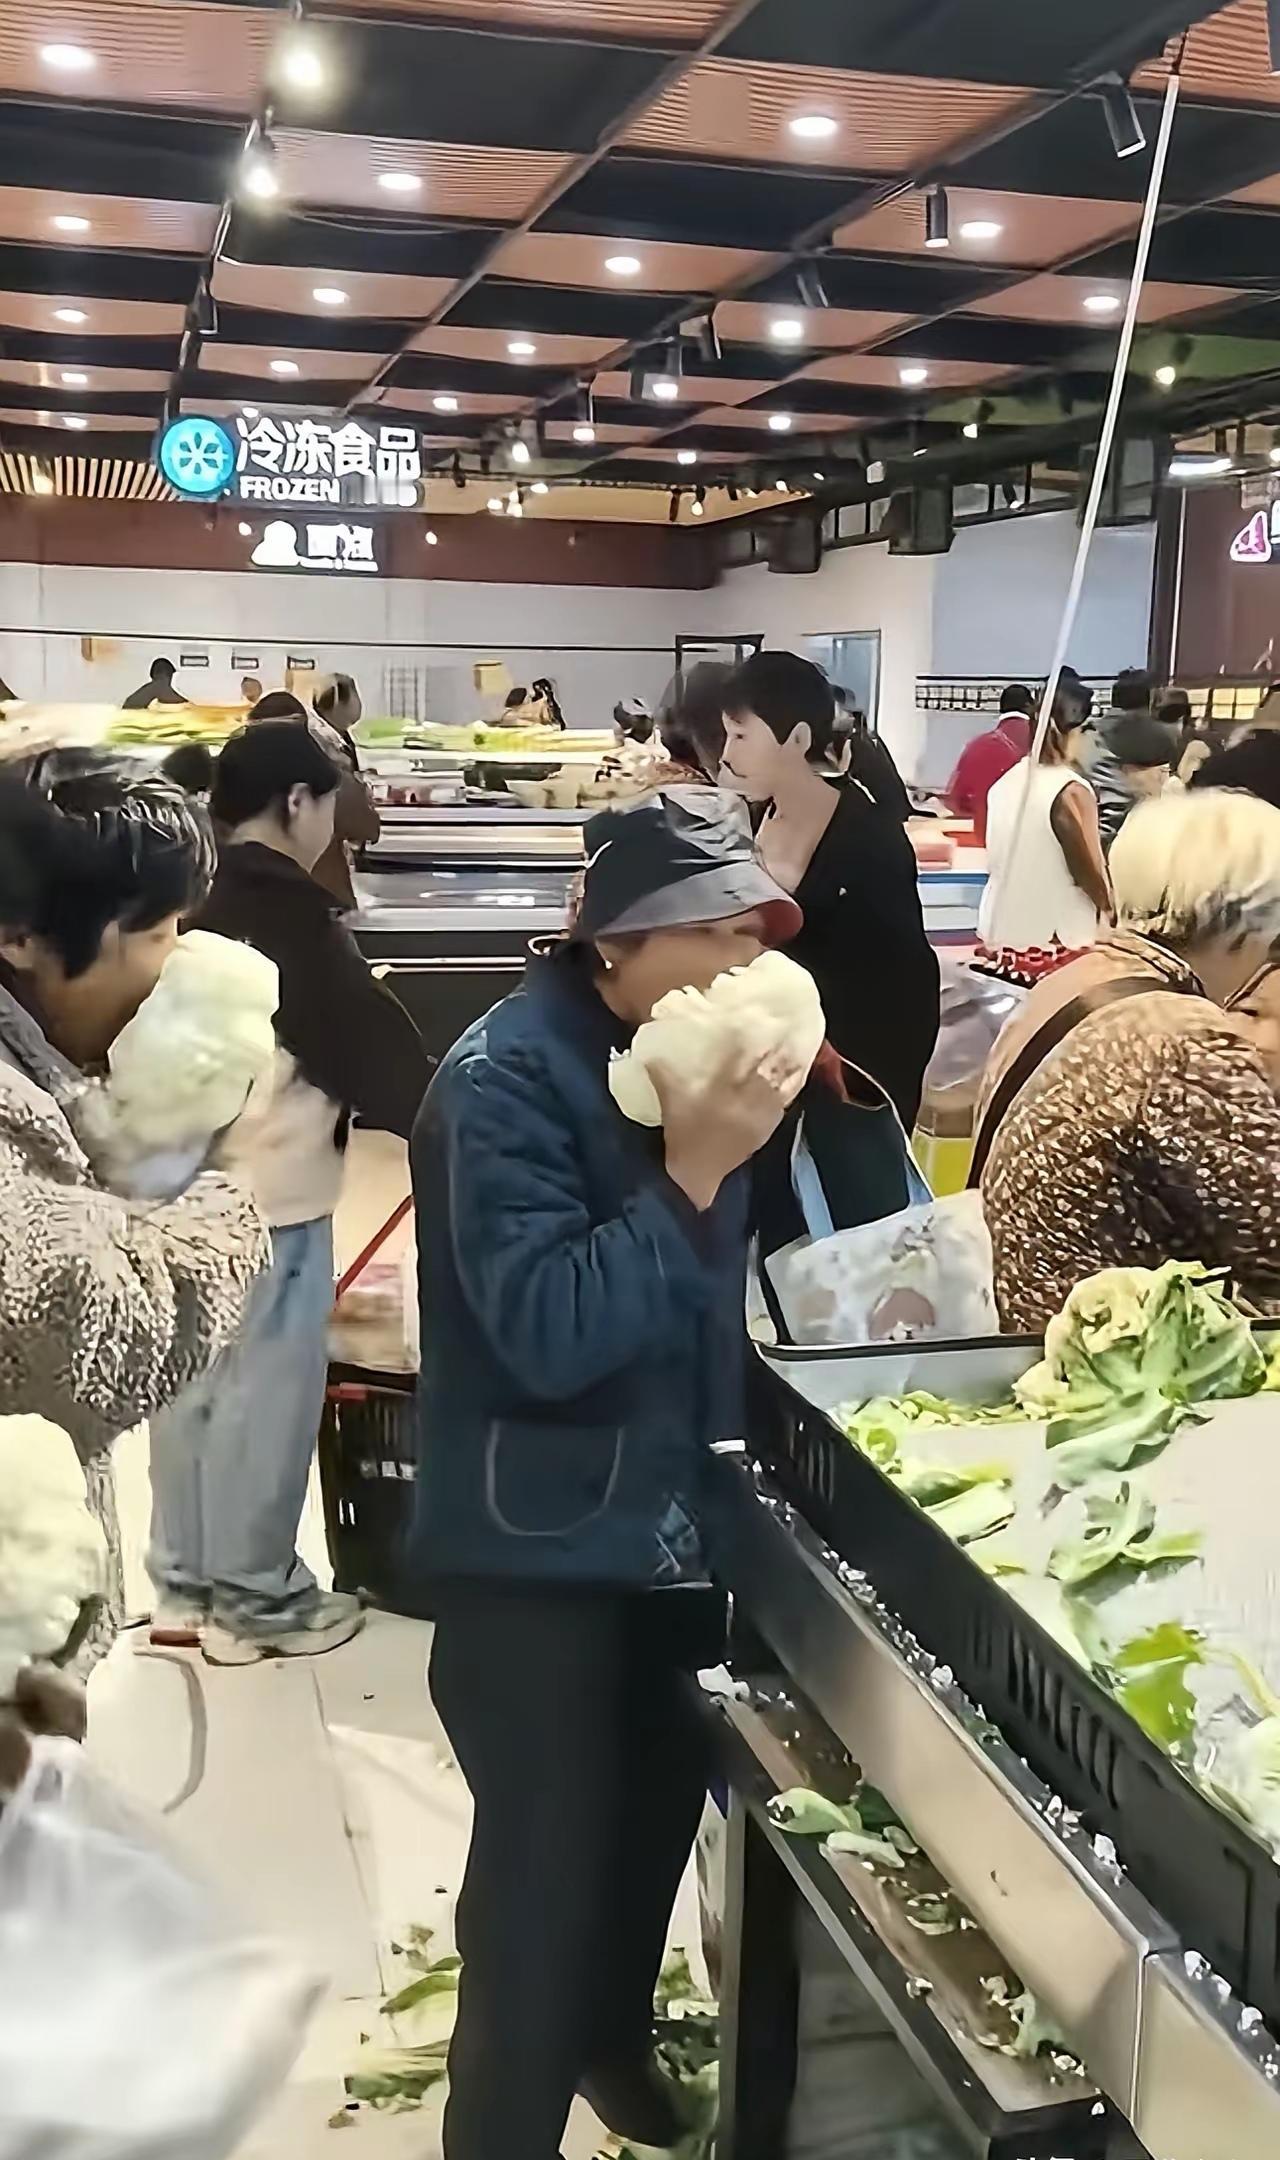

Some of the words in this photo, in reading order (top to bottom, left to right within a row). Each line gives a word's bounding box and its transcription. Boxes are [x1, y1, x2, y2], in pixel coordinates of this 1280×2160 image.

[236, 417, 421, 480] 冷冻食品
[239, 476, 340, 503] FROZEN
